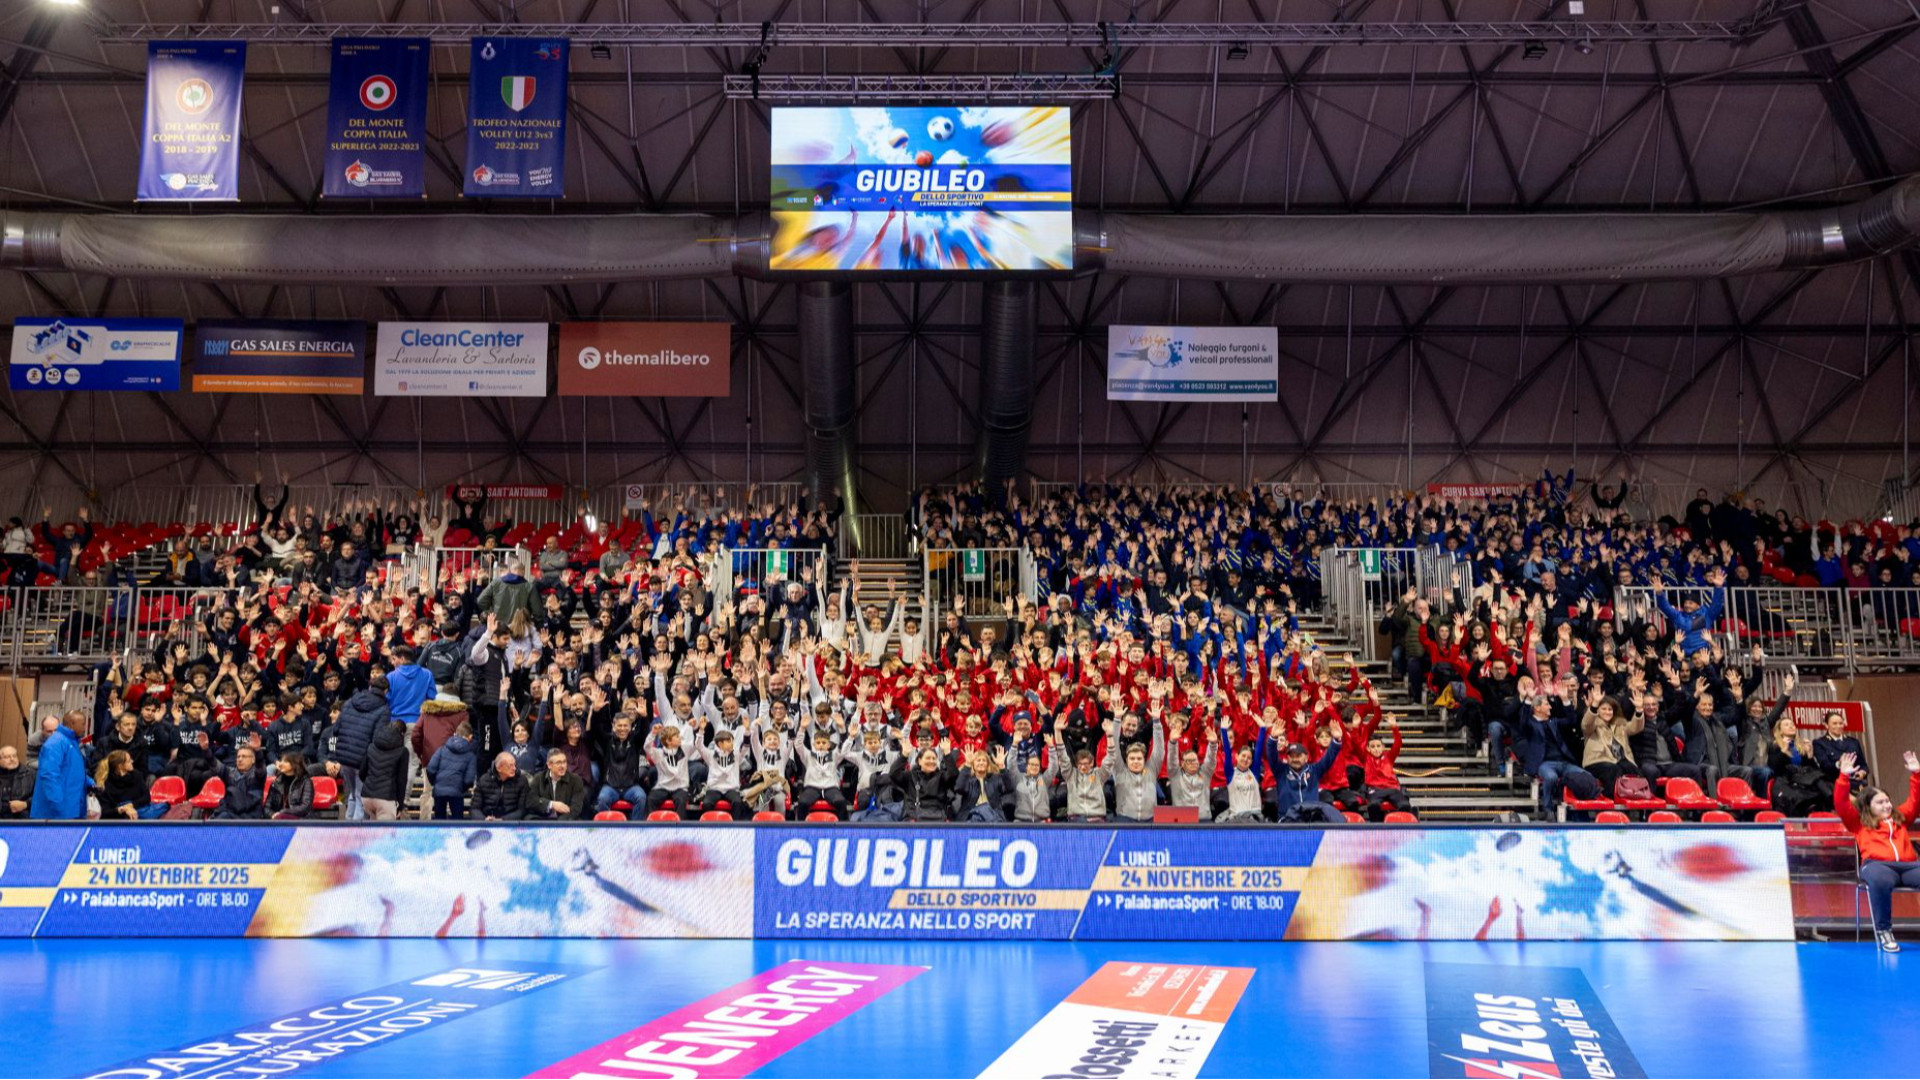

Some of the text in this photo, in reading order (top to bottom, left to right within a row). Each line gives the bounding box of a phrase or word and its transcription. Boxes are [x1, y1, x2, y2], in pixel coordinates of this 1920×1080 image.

[165, 122, 220, 131] DEL MONTE
[349, 119, 404, 128] DEL MONTE
[473, 119, 562, 128] TROFEO NAZIONALE
[153, 134, 232, 143] COPPA ITALIA A2
[344, 130, 408, 139] COPPA ITALIA
[480, 131, 553, 139] VOLLEY U12 3vs3
[165, 145, 187, 154] 2018
[195, 145, 218, 154] 2019
[331, 143, 420, 151] SUPERLEGA 2022-2023
[495, 142, 539, 150] 2022-2023
[856, 169, 985, 192] GIUBILEO
[401, 328, 524, 347] CleanCenter
[230, 339, 355, 353] GAS SALES ENERGIA
[1188, 343, 1227, 353] Noleggio
[1229, 343, 1260, 353] furgoni
[387, 347, 536, 365] Lavanderia & Sartoria
[605, 350, 710, 365] themalibero
[1189, 355, 1273, 365] veicoli professionali
[487, 487, 548, 498] SANT'ANTONINO
[1442, 486, 1468, 497] CURVA
[89, 845, 141, 864] LUNEDÌ
[1119, 848, 1171, 867] LUNEDÌ
[775, 838, 1039, 888] GIUBILEO
[88, 866, 250, 886] 24 NOVEMBRE 2025
[1120, 869, 1283, 888] 24 NOVEMBRE 2025
[81, 891, 185, 910] PalabancaSport
[196, 892, 218, 907] ORE
[221, 892, 249, 907] 18.00
[906, 893, 1038, 907] DELLO SPORTIVO
[1115, 894, 1220, 913] PalabancaSport
[1231, 895, 1253, 910] ORE
[1255, 895, 1284, 910] 18.00
[774, 912, 1036, 930] LA SPERANZA NELLO SPORT
[1041, 1018, 1159, 1080] ossetti
